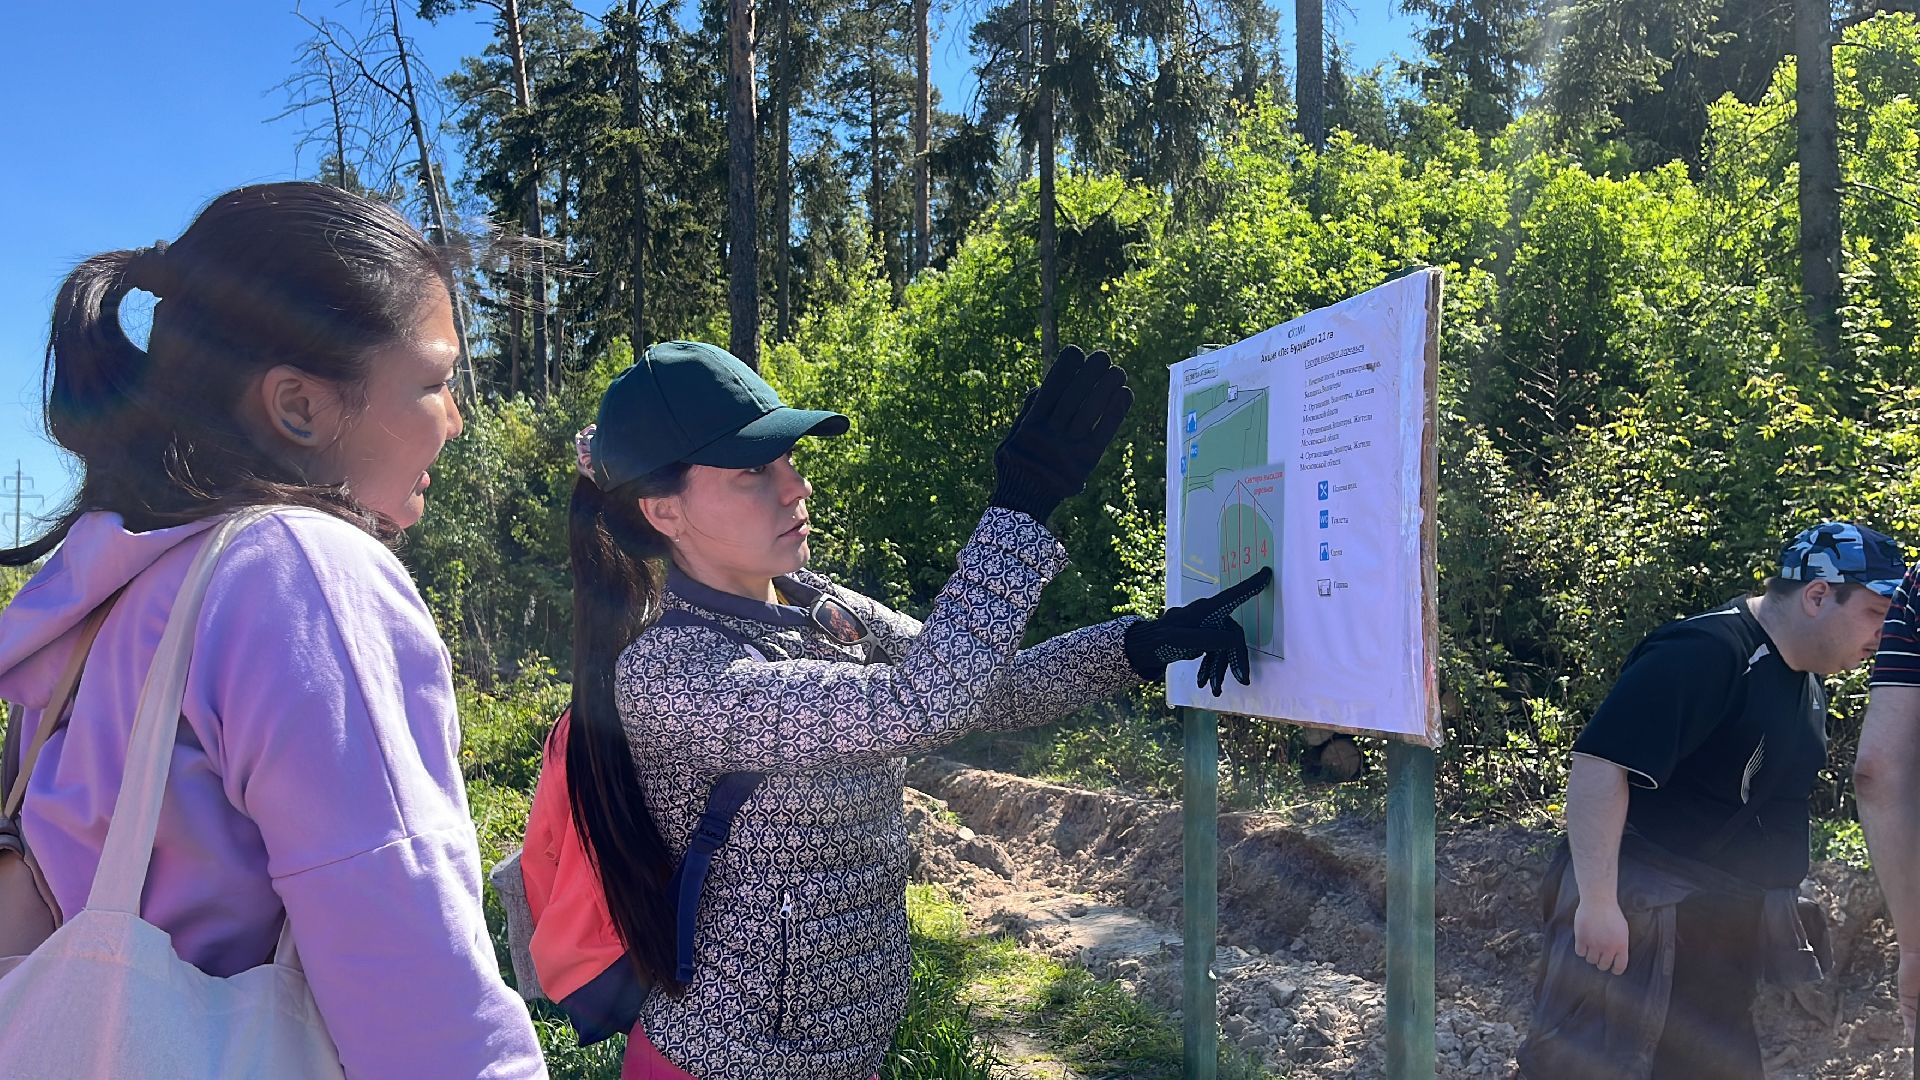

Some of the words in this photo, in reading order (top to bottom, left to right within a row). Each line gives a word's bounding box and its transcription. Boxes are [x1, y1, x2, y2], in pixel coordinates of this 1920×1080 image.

[1244, 546, 1251, 565] 3
[1261, 538, 1268, 558] 4
[1231, 551, 1237, 569] 2
